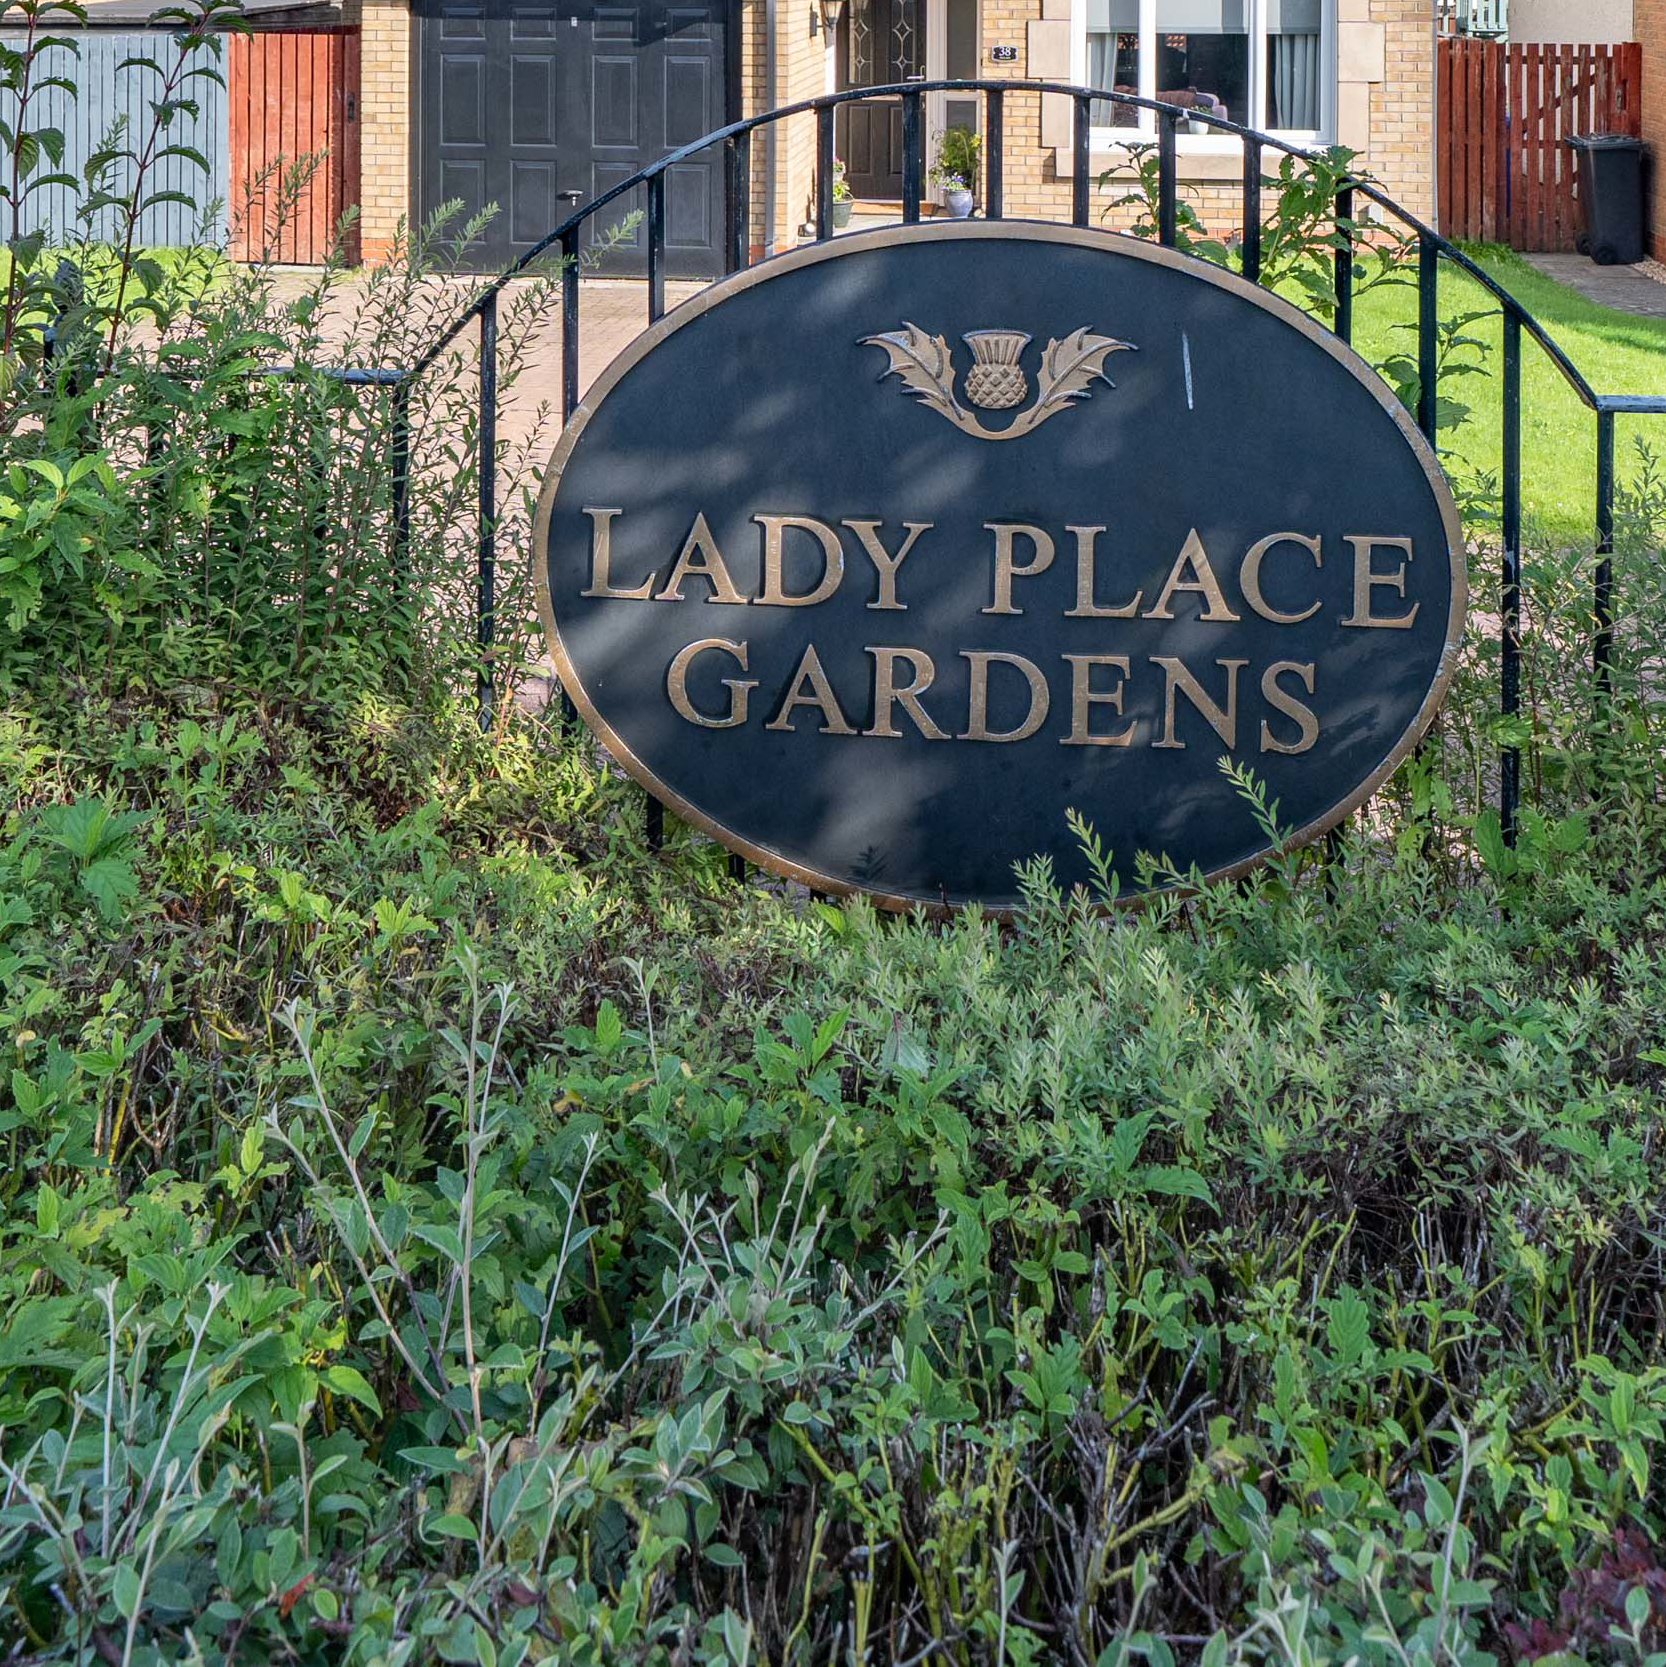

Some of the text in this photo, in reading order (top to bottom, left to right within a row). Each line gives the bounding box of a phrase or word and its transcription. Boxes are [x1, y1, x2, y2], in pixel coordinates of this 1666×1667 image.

[998, 45, 1012, 56] 38
[580, 505, 1421, 630] LADY PLACE
[665, 636, 1321, 755] GARDENS
